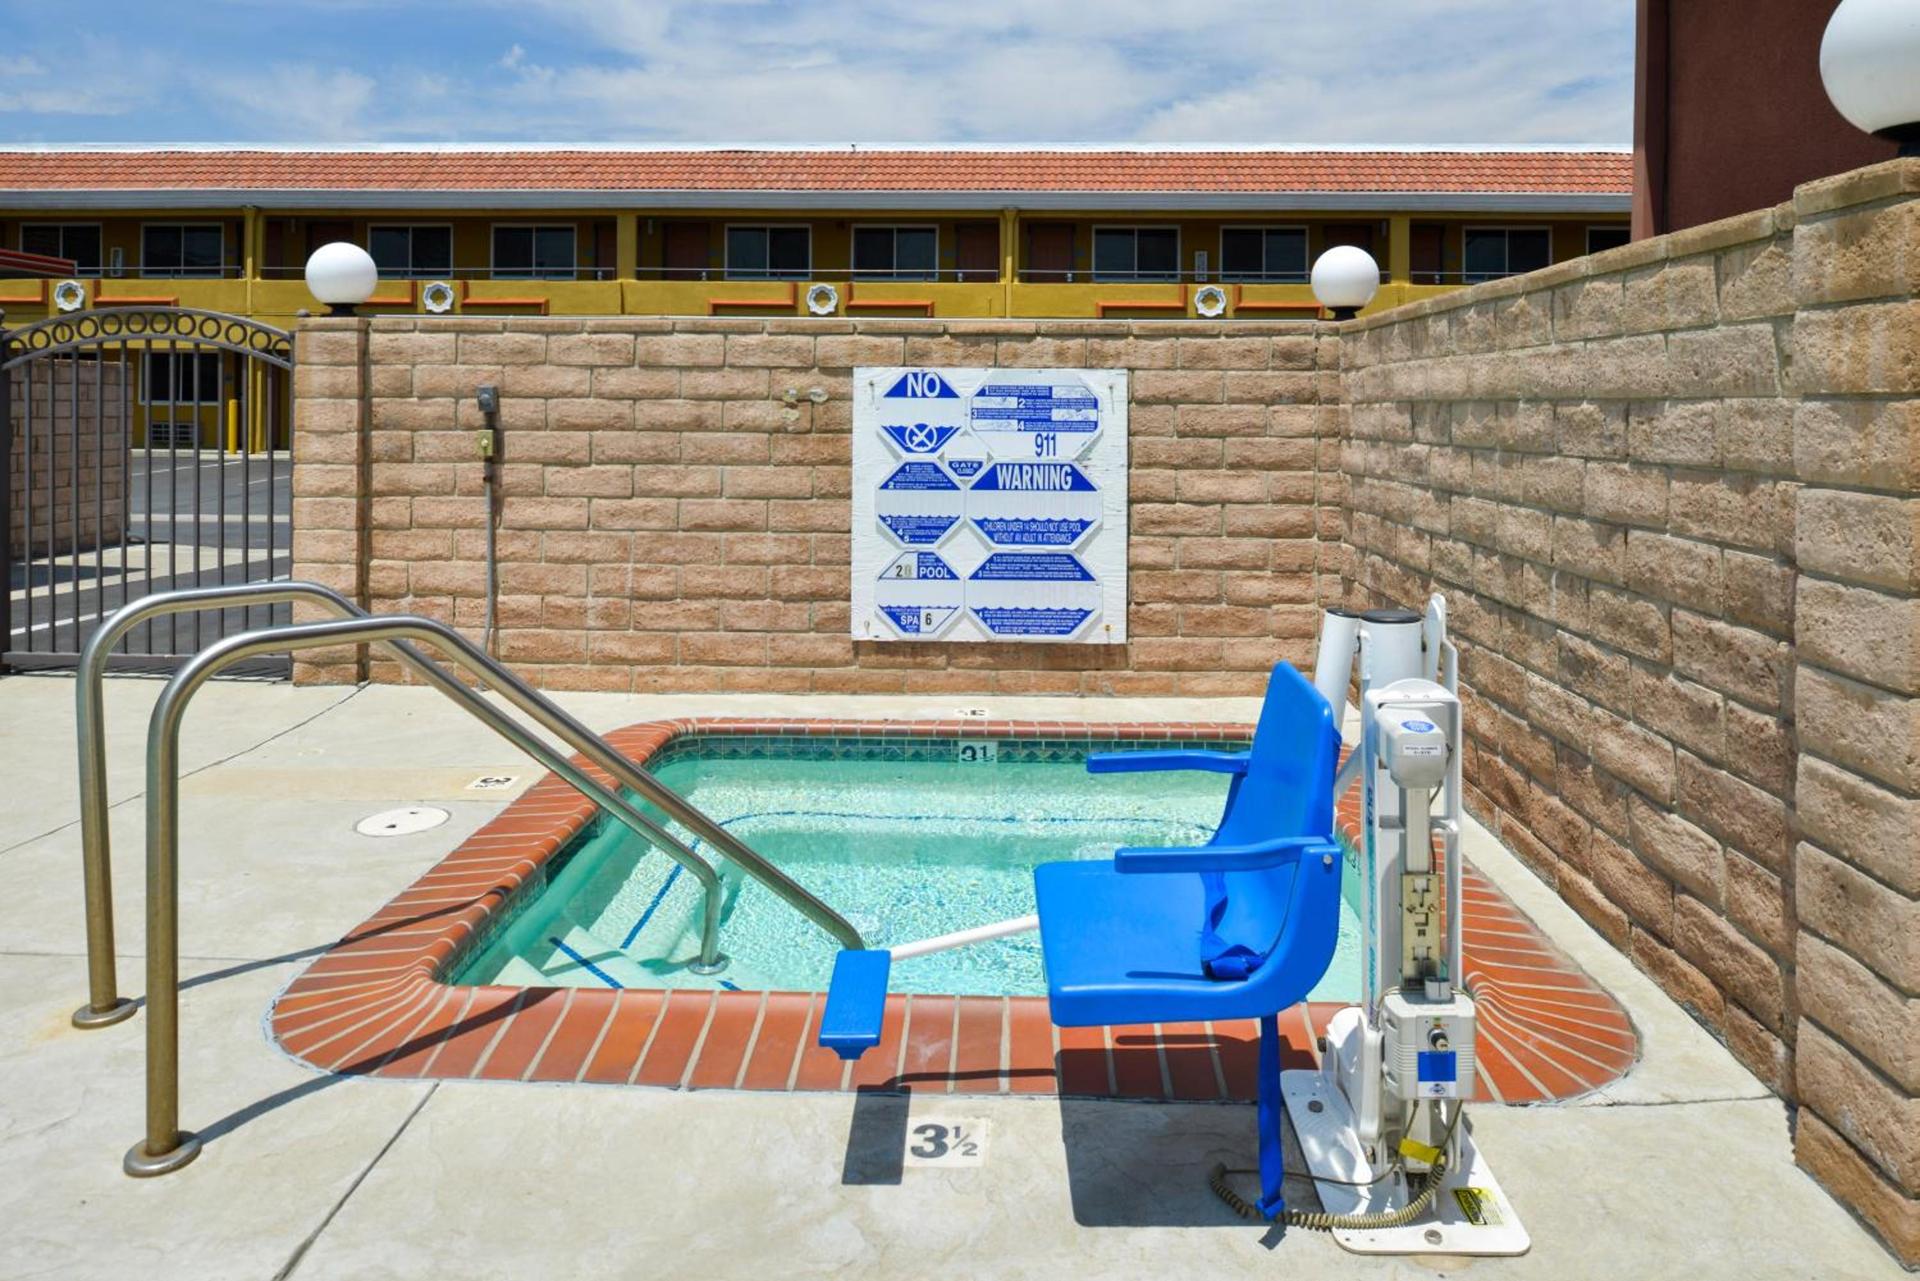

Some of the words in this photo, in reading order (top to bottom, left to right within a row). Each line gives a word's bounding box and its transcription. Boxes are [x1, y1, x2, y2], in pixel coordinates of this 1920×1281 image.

[907, 373, 941, 397] NO
[1019, 399, 1026, 408] 2
[971, 409, 978, 418] 3
[1018, 421, 1025, 431] 4
[1035, 433, 1057, 457] 911
[905, 464, 910, 472] 1
[996, 464, 1072, 490] WARNING
[897, 528, 903, 536] 4
[920, 567, 951, 578] POOL
[900, 615, 919, 625] SPA
[925, 613, 932, 625] 6
